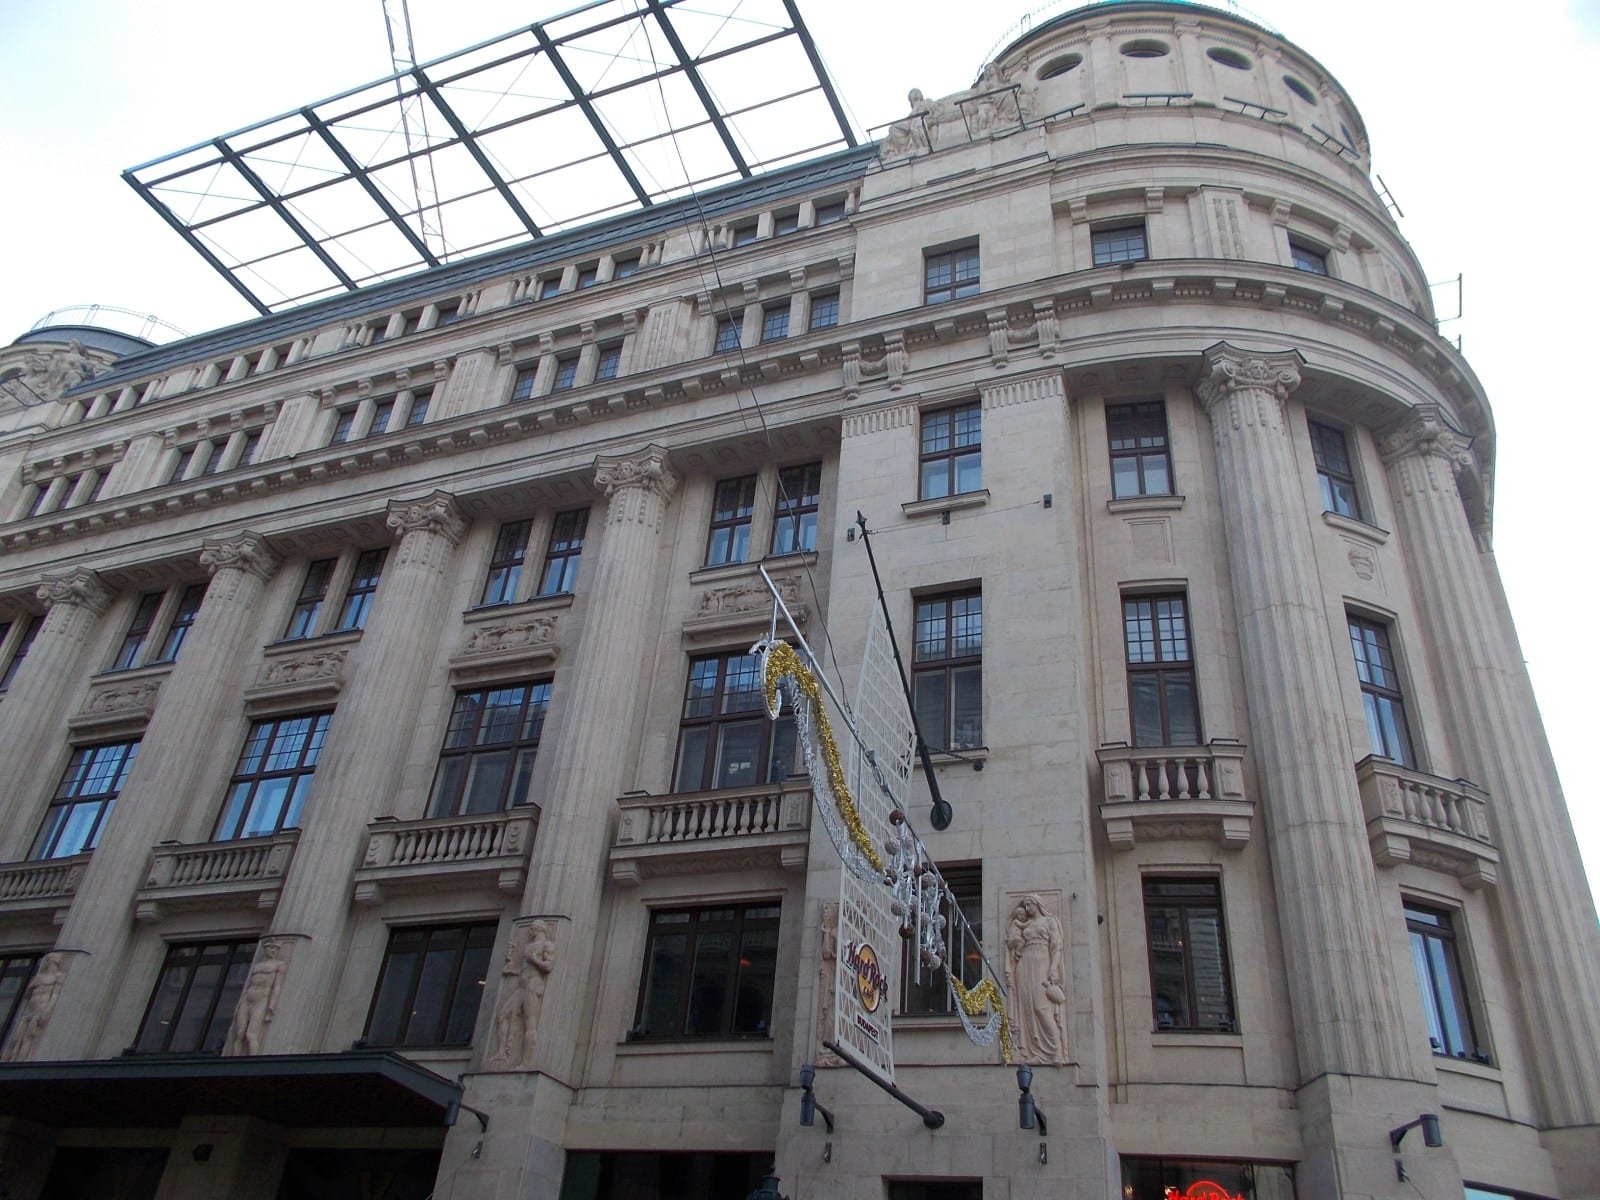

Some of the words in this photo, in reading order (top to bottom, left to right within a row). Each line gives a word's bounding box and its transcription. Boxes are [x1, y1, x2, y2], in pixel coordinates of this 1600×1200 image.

[846, 942, 871, 979] Hard
[869, 962, 889, 1001] Rock
[857, 1014, 879, 1040] BUDAPEST
